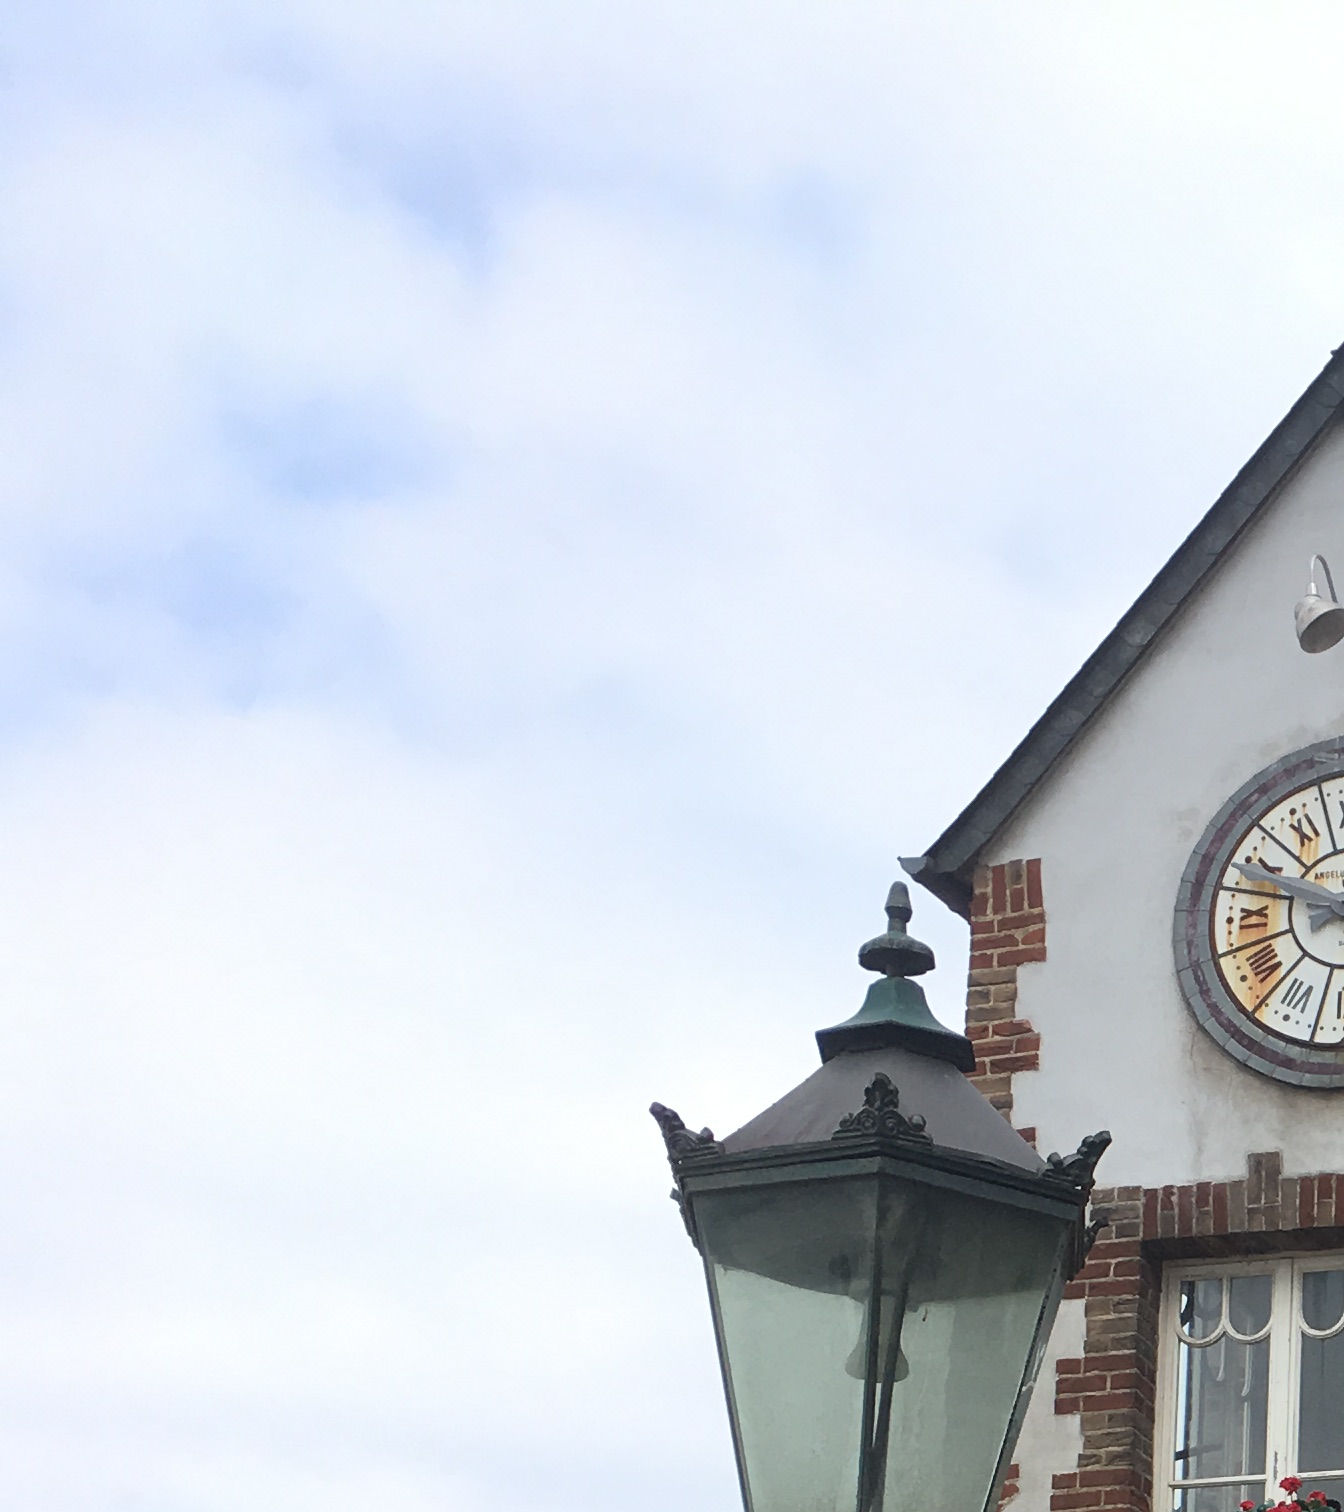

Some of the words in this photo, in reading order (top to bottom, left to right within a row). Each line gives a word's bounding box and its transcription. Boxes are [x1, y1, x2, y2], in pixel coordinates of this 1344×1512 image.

[1289, 813, 1320, 847] XI
[1239, 905, 1269, 930] IX
[1281, 977, 1314, 1014] VII
